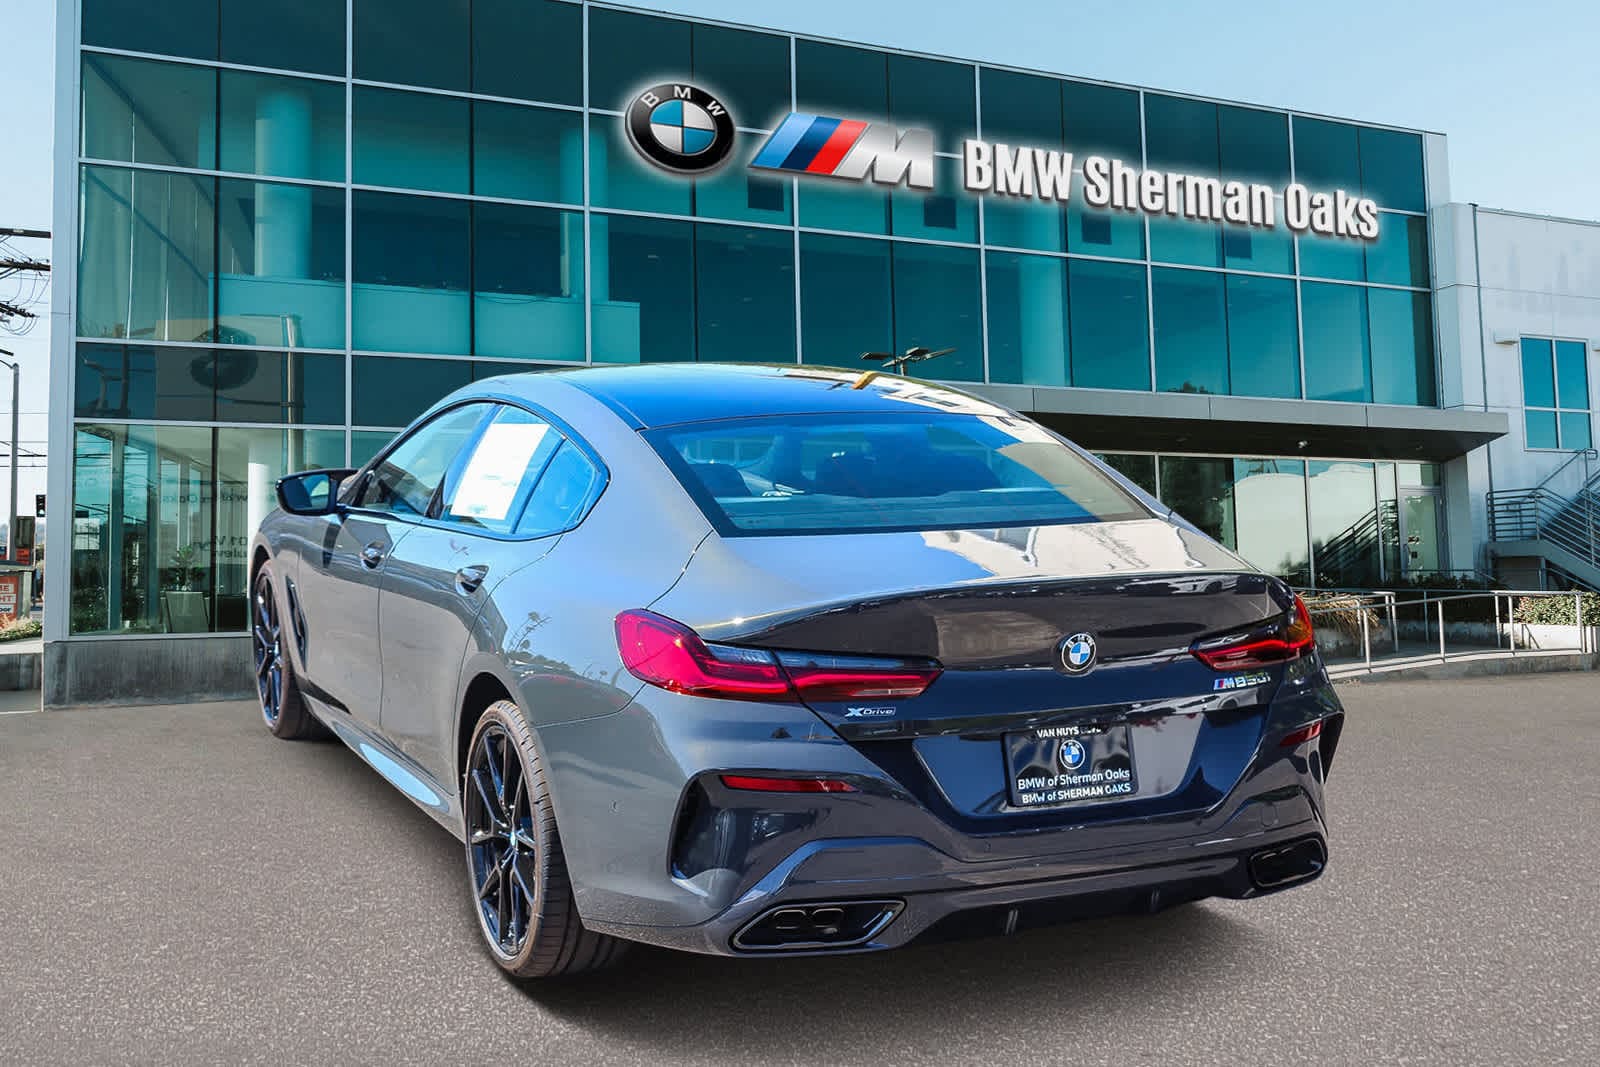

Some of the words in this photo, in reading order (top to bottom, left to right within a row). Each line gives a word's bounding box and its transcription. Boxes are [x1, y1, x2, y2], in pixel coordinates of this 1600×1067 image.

[640, 85, 725, 117] BMW
[964, 139, 1073, 204] BMW
[1083, 156, 1275, 226] Sherman
[1284, 183, 1379, 240] Oaks
[1037, 729, 1055, 738] VAN
[1056, 726, 1079, 736] NUYS
[1018, 777, 1045, 790] BMW
[1047, 775, 1058, 786] of
[1059, 772, 1103, 785] Sherman
[1105, 768, 1130, 780] Oaks
[1022, 793, 1045, 804] BMW
[1047, 791, 1057, 801] of
[1057, 785, 1103, 799] SHERMAN
[1105, 783, 1131, 794] OAKS
